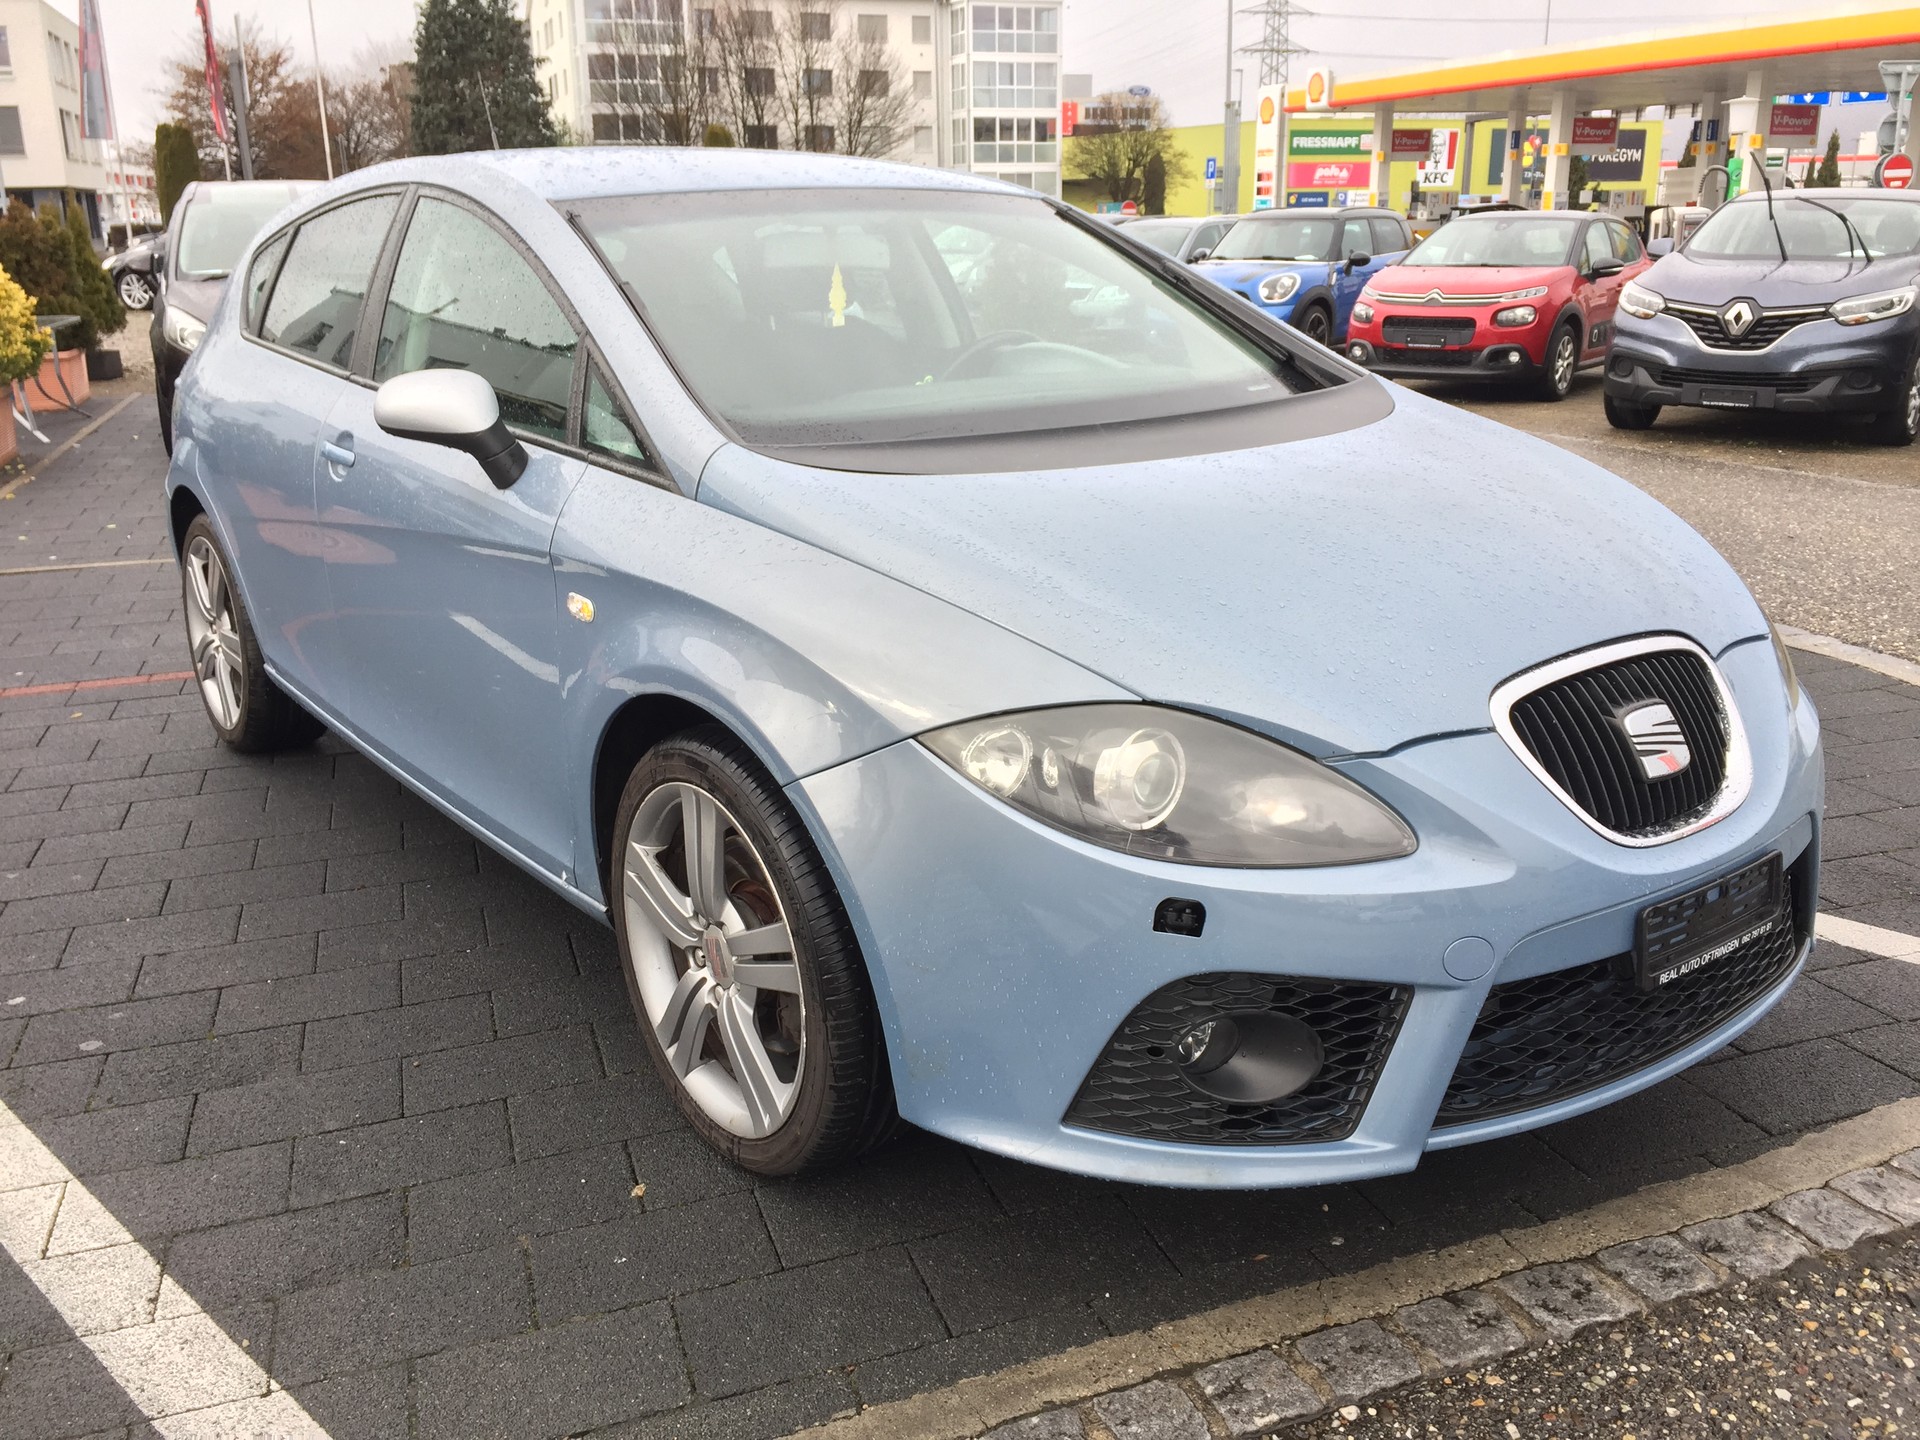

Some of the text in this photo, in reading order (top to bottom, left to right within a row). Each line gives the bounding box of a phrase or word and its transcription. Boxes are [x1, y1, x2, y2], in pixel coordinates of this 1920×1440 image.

[1773, 115, 1813, 126] V-Power
[1575, 127, 1612, 136] V-Power
[1292, 136, 1359, 148] FRESSNAPF
[1208, 160, 1214, 177] P
[1423, 172, 1449, 184] KFC
[1659, 968, 1678, 985] REAL
[1679, 957, 1701, 976] AUTO
[1701, 938, 1740, 965] OFTRINGEN
